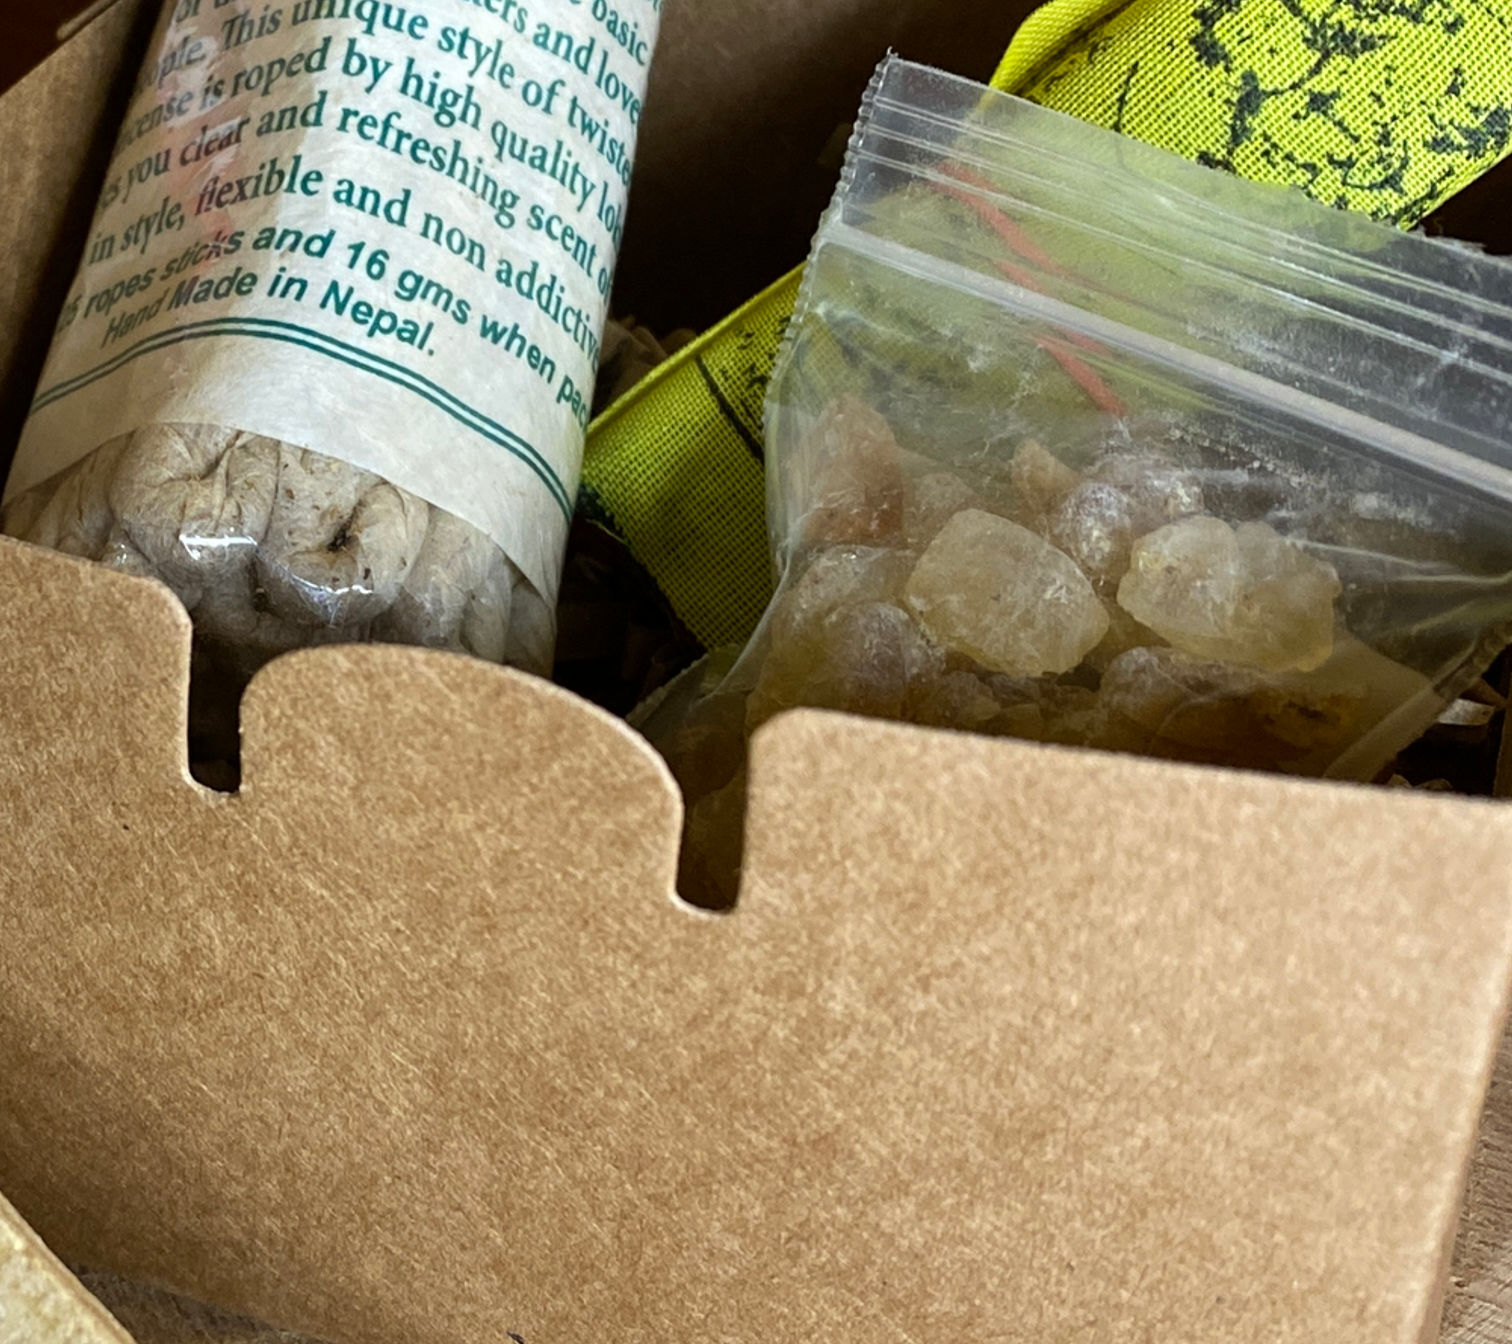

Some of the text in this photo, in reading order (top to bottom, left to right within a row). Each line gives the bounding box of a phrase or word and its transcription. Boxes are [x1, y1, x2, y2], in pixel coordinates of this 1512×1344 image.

[199, 75, 225, 109] is
[231, 36, 332, 97] roped
[342, 38, 393, 94] by
[398, 56, 482, 131] high
[491, 120, 596, 212] quality
[222, 6, 282, 51] This
[438, 25, 514, 89] style
[522, 78, 566, 115] of
[568, 95, 632, 186] twiste
[533, 22, 595, 75] and
[595, 50, 640, 124] love
[120, 196, 184, 255] style,
[194, 155, 323, 216] flexible
[333, 177, 412, 228] and
[419, 212, 486, 272] non
[123, 148, 170, 204] you
[180, 117, 250, 166] clear
[256, 90, 328, 137] and
[337, 106, 520, 229] refreshing
[527, 204, 597, 279] scent
[84, 267, 157, 318] ropes
[160, 230, 245, 281] sticks
[252, 226, 336, 259] and
[347, 241, 390, 281] 16
[394, 268, 471, 325] gms
[479, 315, 556, 383] when
[101, 266, 435, 356] Hand Made in Nepal.
